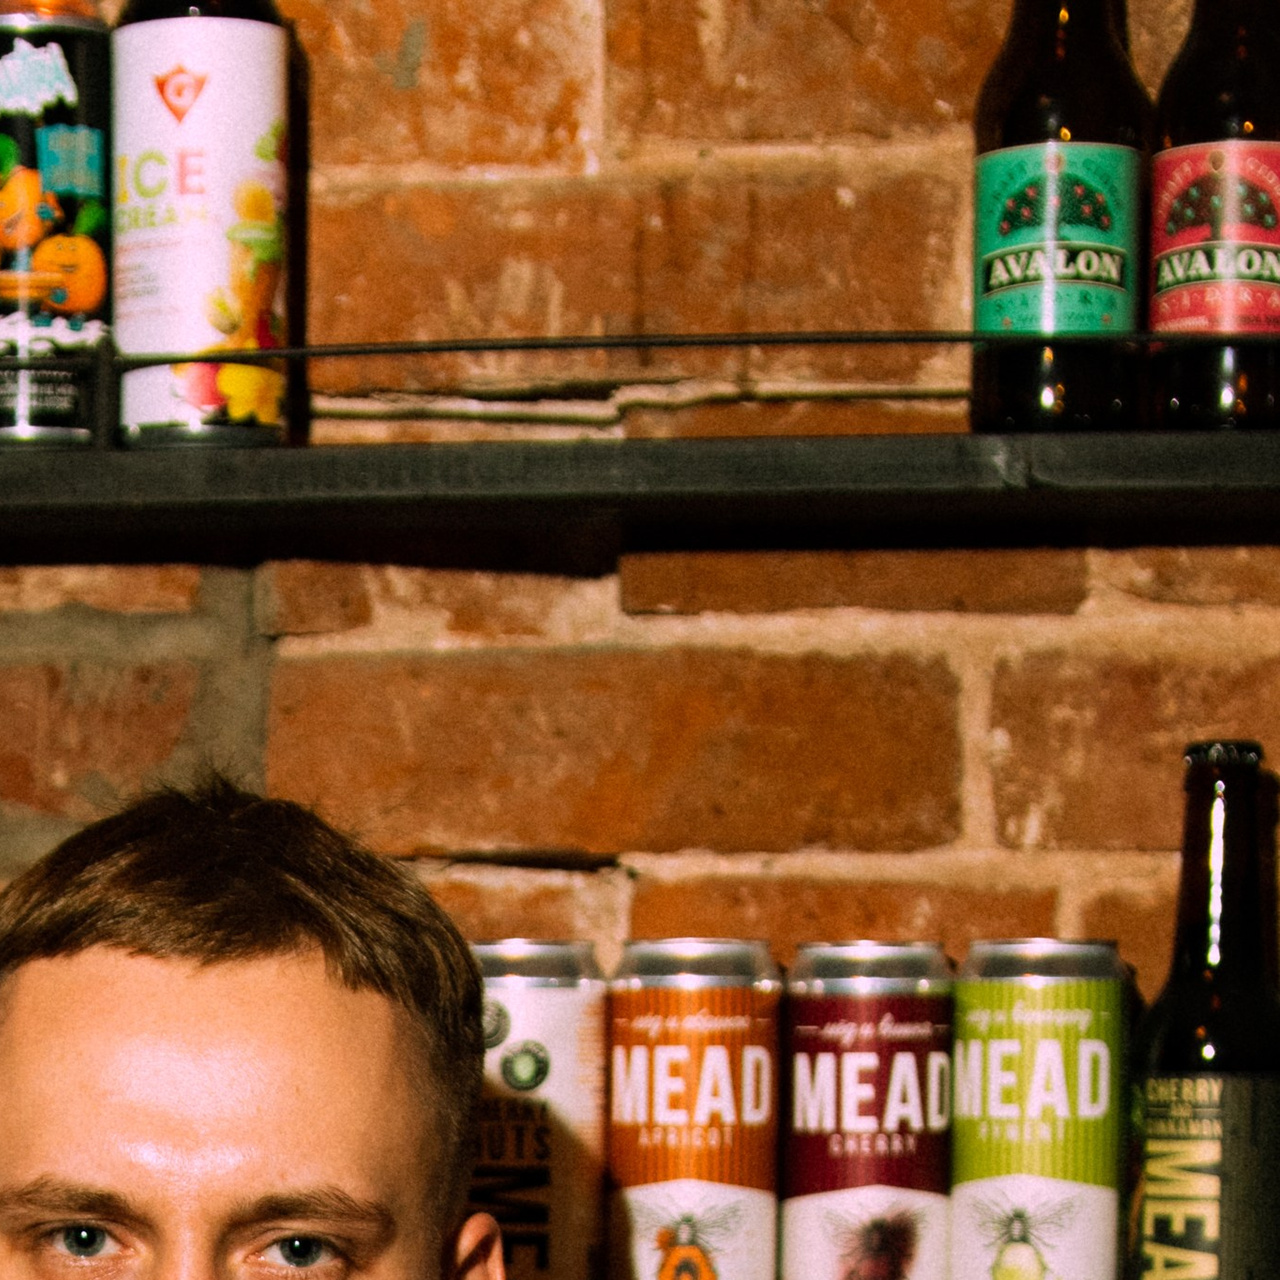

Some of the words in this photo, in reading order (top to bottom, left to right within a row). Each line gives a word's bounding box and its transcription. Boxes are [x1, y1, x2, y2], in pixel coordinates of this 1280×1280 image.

[988, 248, 1120, 289] AVALON
[1157, 248, 1280, 289] AVALON
[612, 1044, 773, 1126] MEAD
[793, 1051, 951, 1133] MEAD
[955, 1038, 1112, 1120] MEAD
[638, 1126, 735, 1148] APRICOT
[829, 1133, 917, 1156] CHERRY
